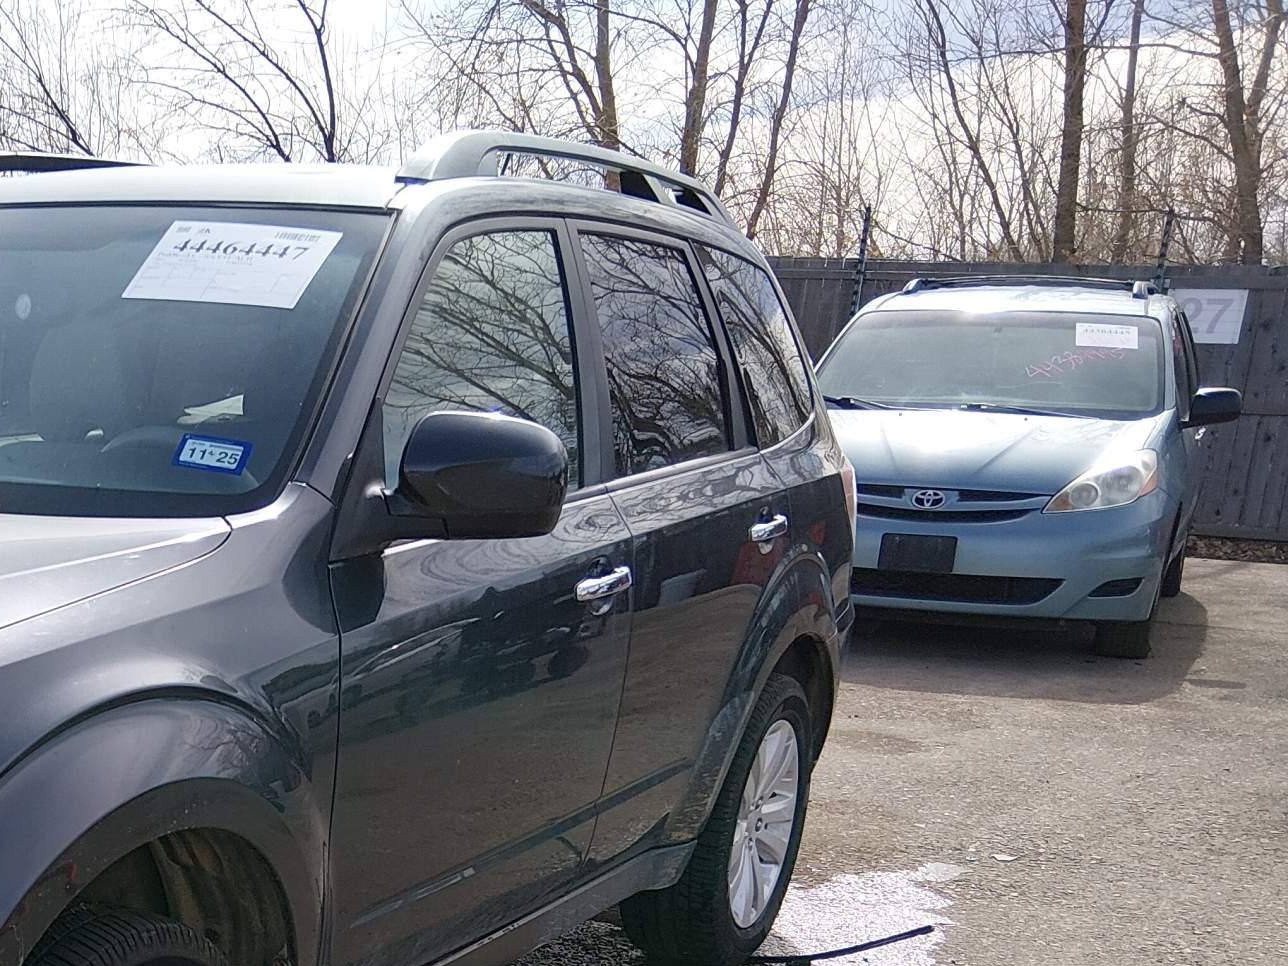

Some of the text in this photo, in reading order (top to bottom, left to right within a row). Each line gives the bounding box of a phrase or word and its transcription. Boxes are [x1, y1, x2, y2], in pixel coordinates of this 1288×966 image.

[173, 238, 311, 260] 44464447
[188, 447, 240, 465] 11 25
